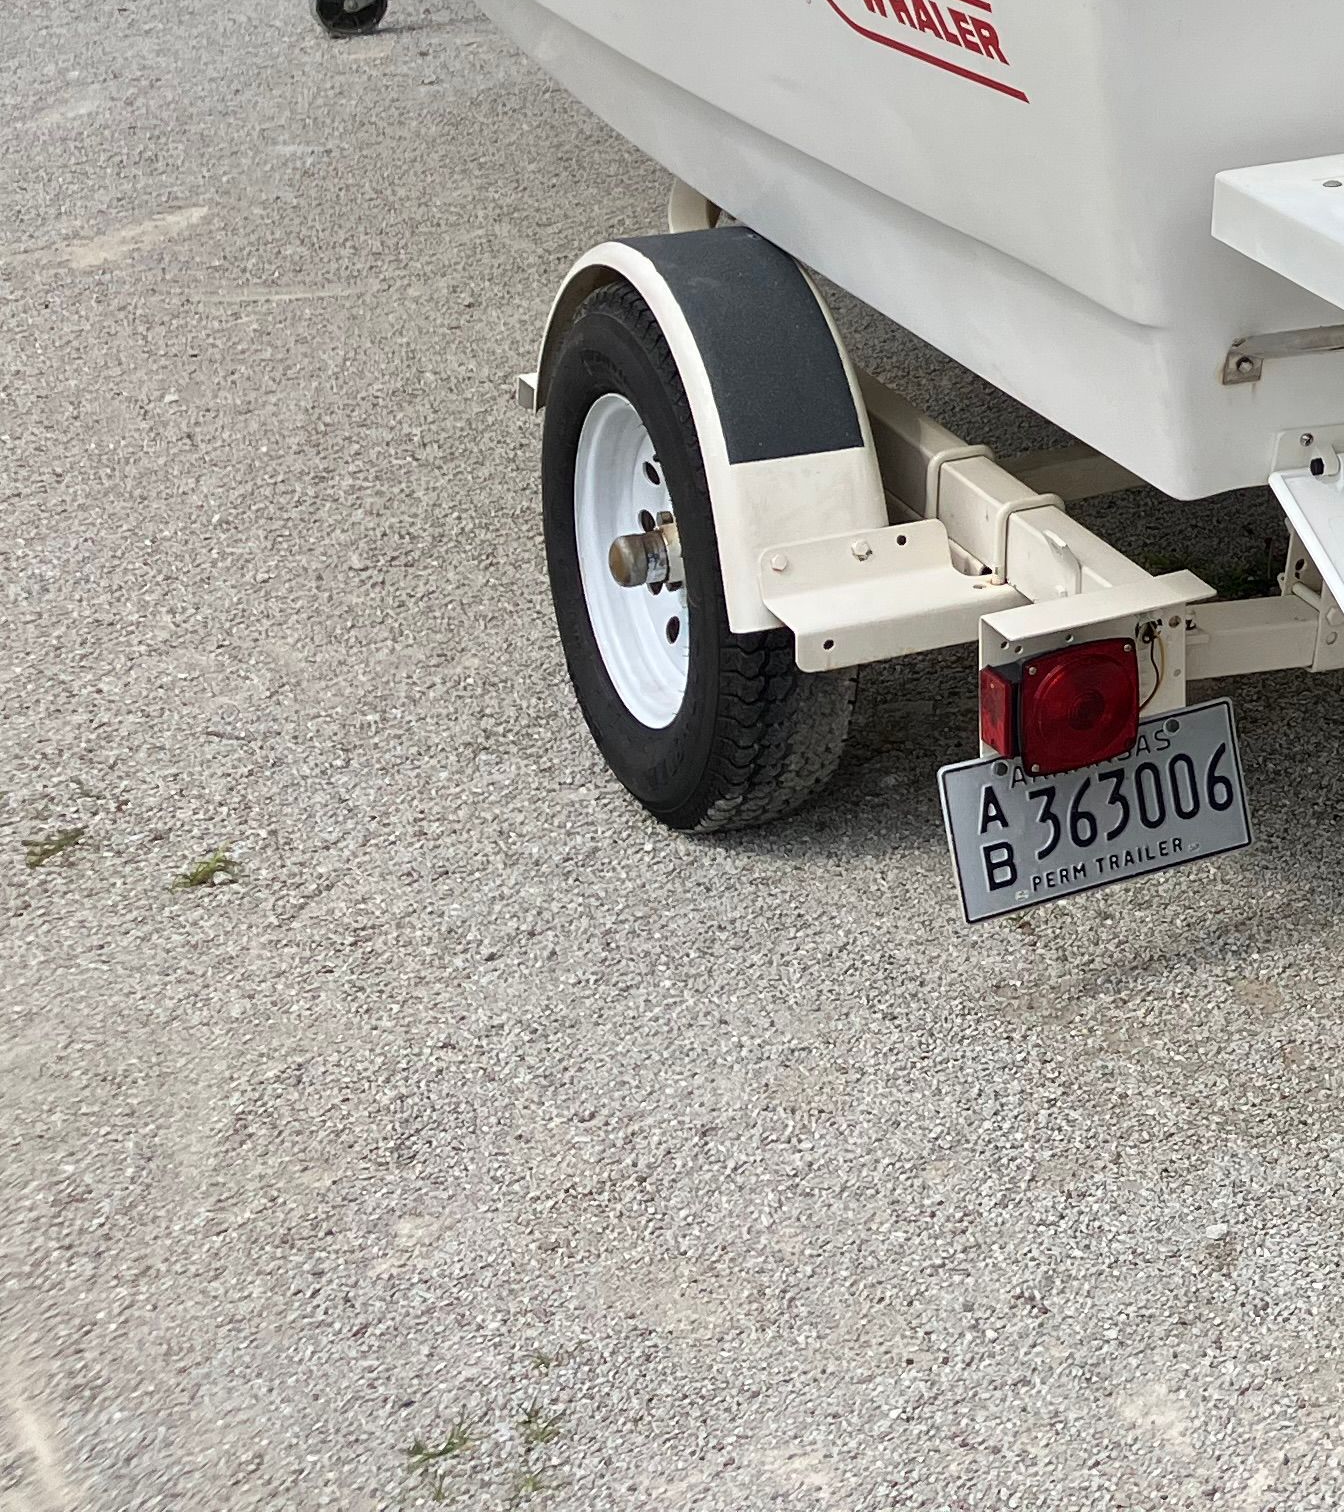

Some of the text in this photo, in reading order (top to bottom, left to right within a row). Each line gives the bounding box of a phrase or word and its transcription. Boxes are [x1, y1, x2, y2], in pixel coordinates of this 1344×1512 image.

[1028, 742, 1234, 861] 363006
[1032, 837, 1183, 892] PERM TRAILER
